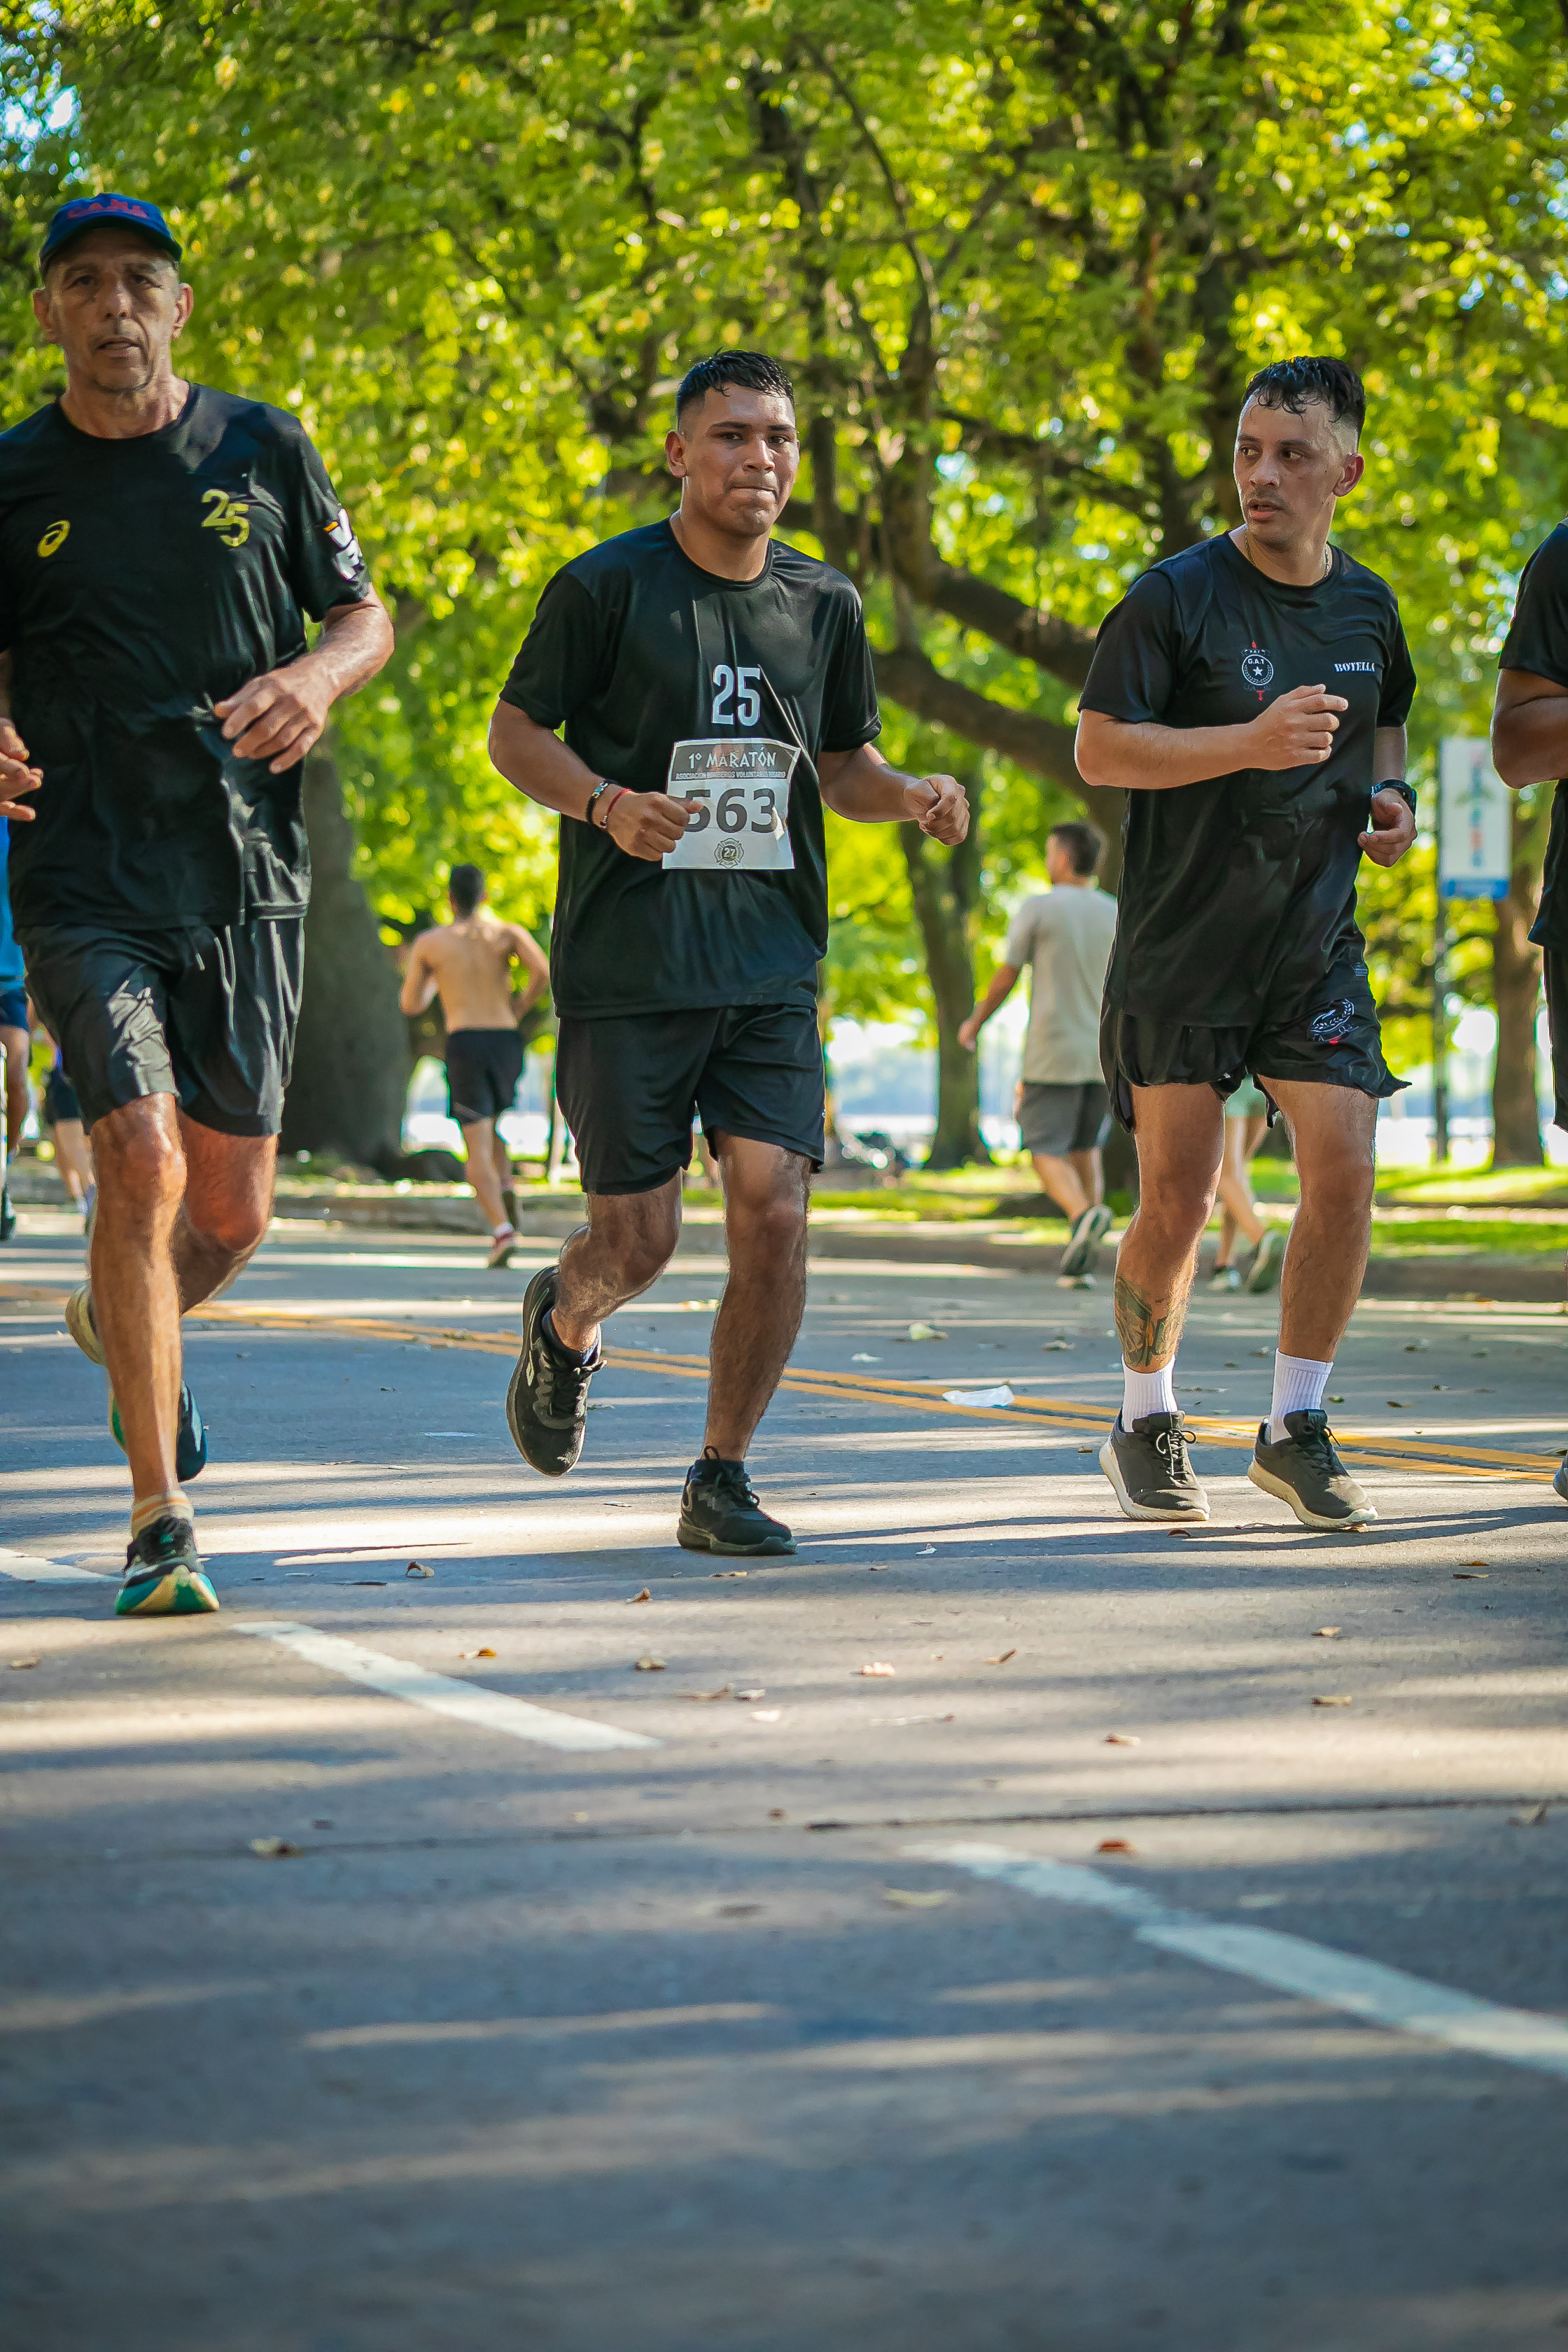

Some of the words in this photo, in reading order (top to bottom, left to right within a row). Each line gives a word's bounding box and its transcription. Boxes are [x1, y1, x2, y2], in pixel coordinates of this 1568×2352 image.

[202, 489, 250, 547] 25
[1334, 662, 1376, 672] BOTELLA
[711, 664, 761, 727] 25
[706, 746, 777, 769] MARATÓN
[684, 788, 778, 834] 563
[724, 847, 736, 858] 27
